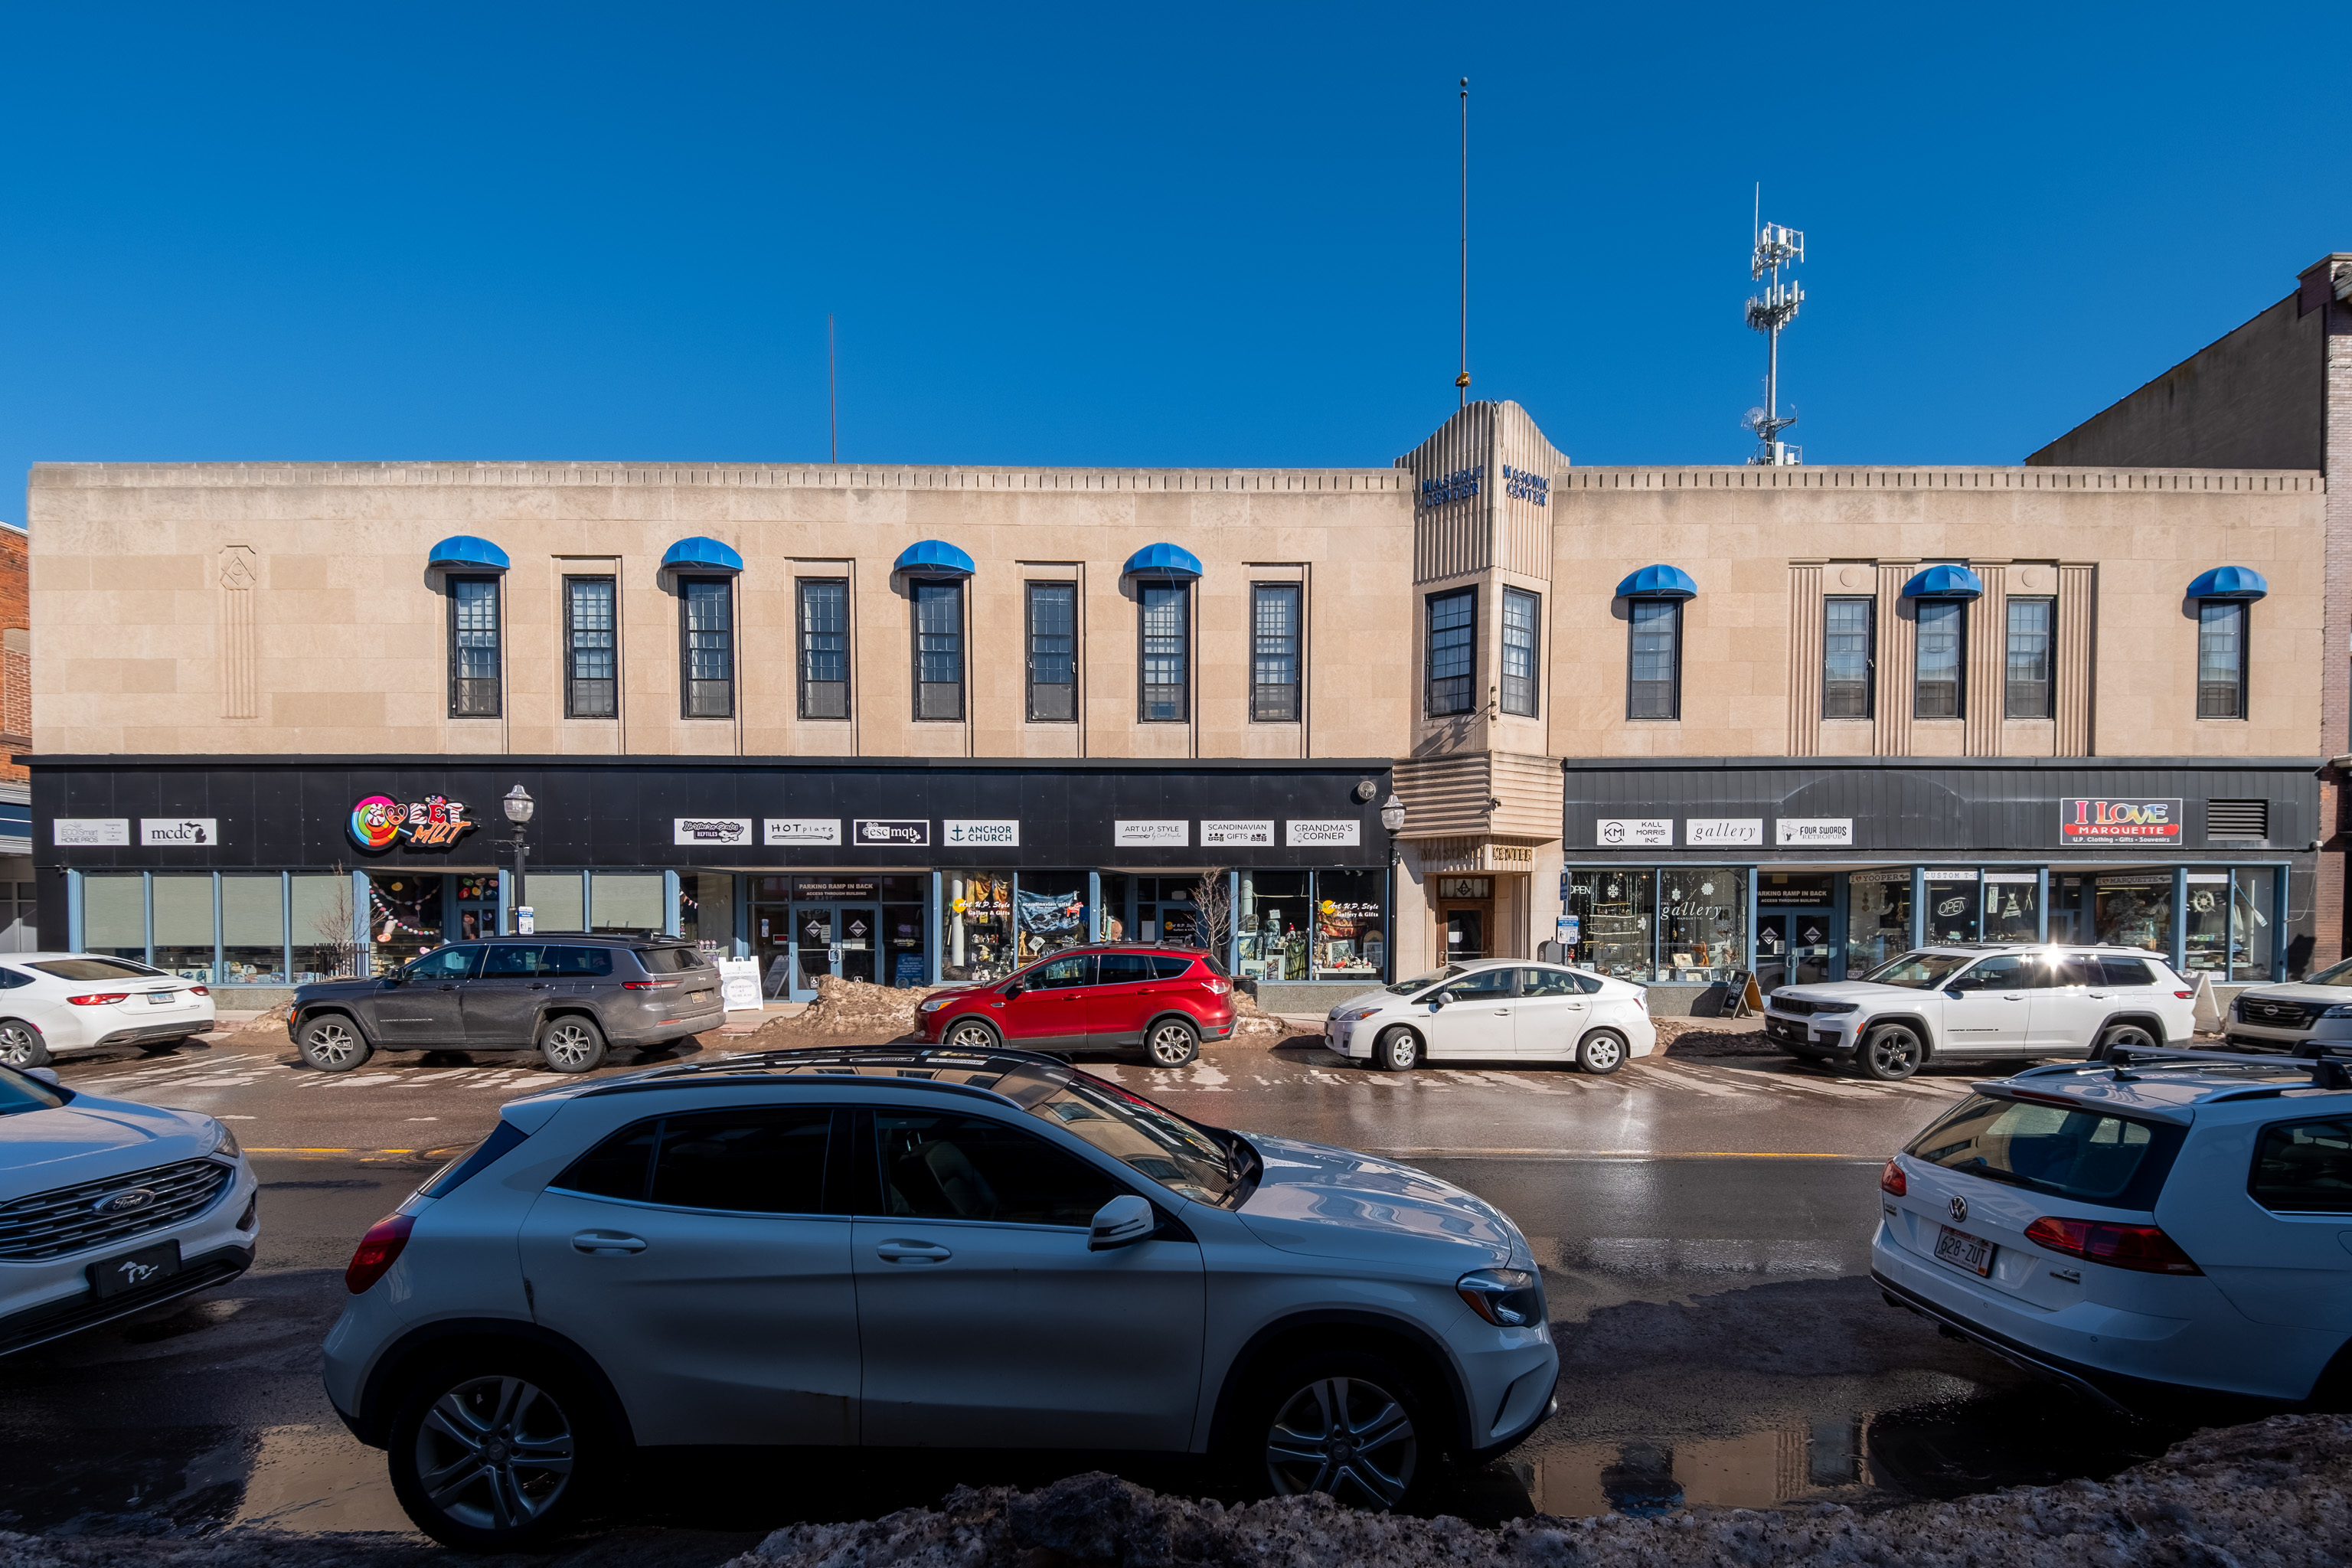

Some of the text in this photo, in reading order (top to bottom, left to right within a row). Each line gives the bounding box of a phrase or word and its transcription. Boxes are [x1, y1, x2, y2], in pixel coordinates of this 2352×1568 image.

[1422, 464, 1485, 494] MASONIC
[1503, 464, 1550, 493] MASONIC
[1427, 482, 1479, 507] CENTER
[1506, 482, 1546, 507] CENTER
[2075, 801, 2168, 825] I LOVE
[151, 823, 192, 839] mcdc
[1295, 824, 1353, 832] GRANDMA'S
[1604, 828, 1625, 837] KMI
[1694, 822, 1756, 841] gallery
[1800, 826, 1847, 836] FOUR SWORDS
[1421, 845, 1532, 862] MASONIC CENTER
[1328, 901, 1341, 910] Art
[1660, 902, 1722, 920] gallery
[1939, 900, 1965, 913] OPEN
[113, 1195, 142, 1210] Ford
[1941, 1236, 1987, 1267] 628-ZUT
